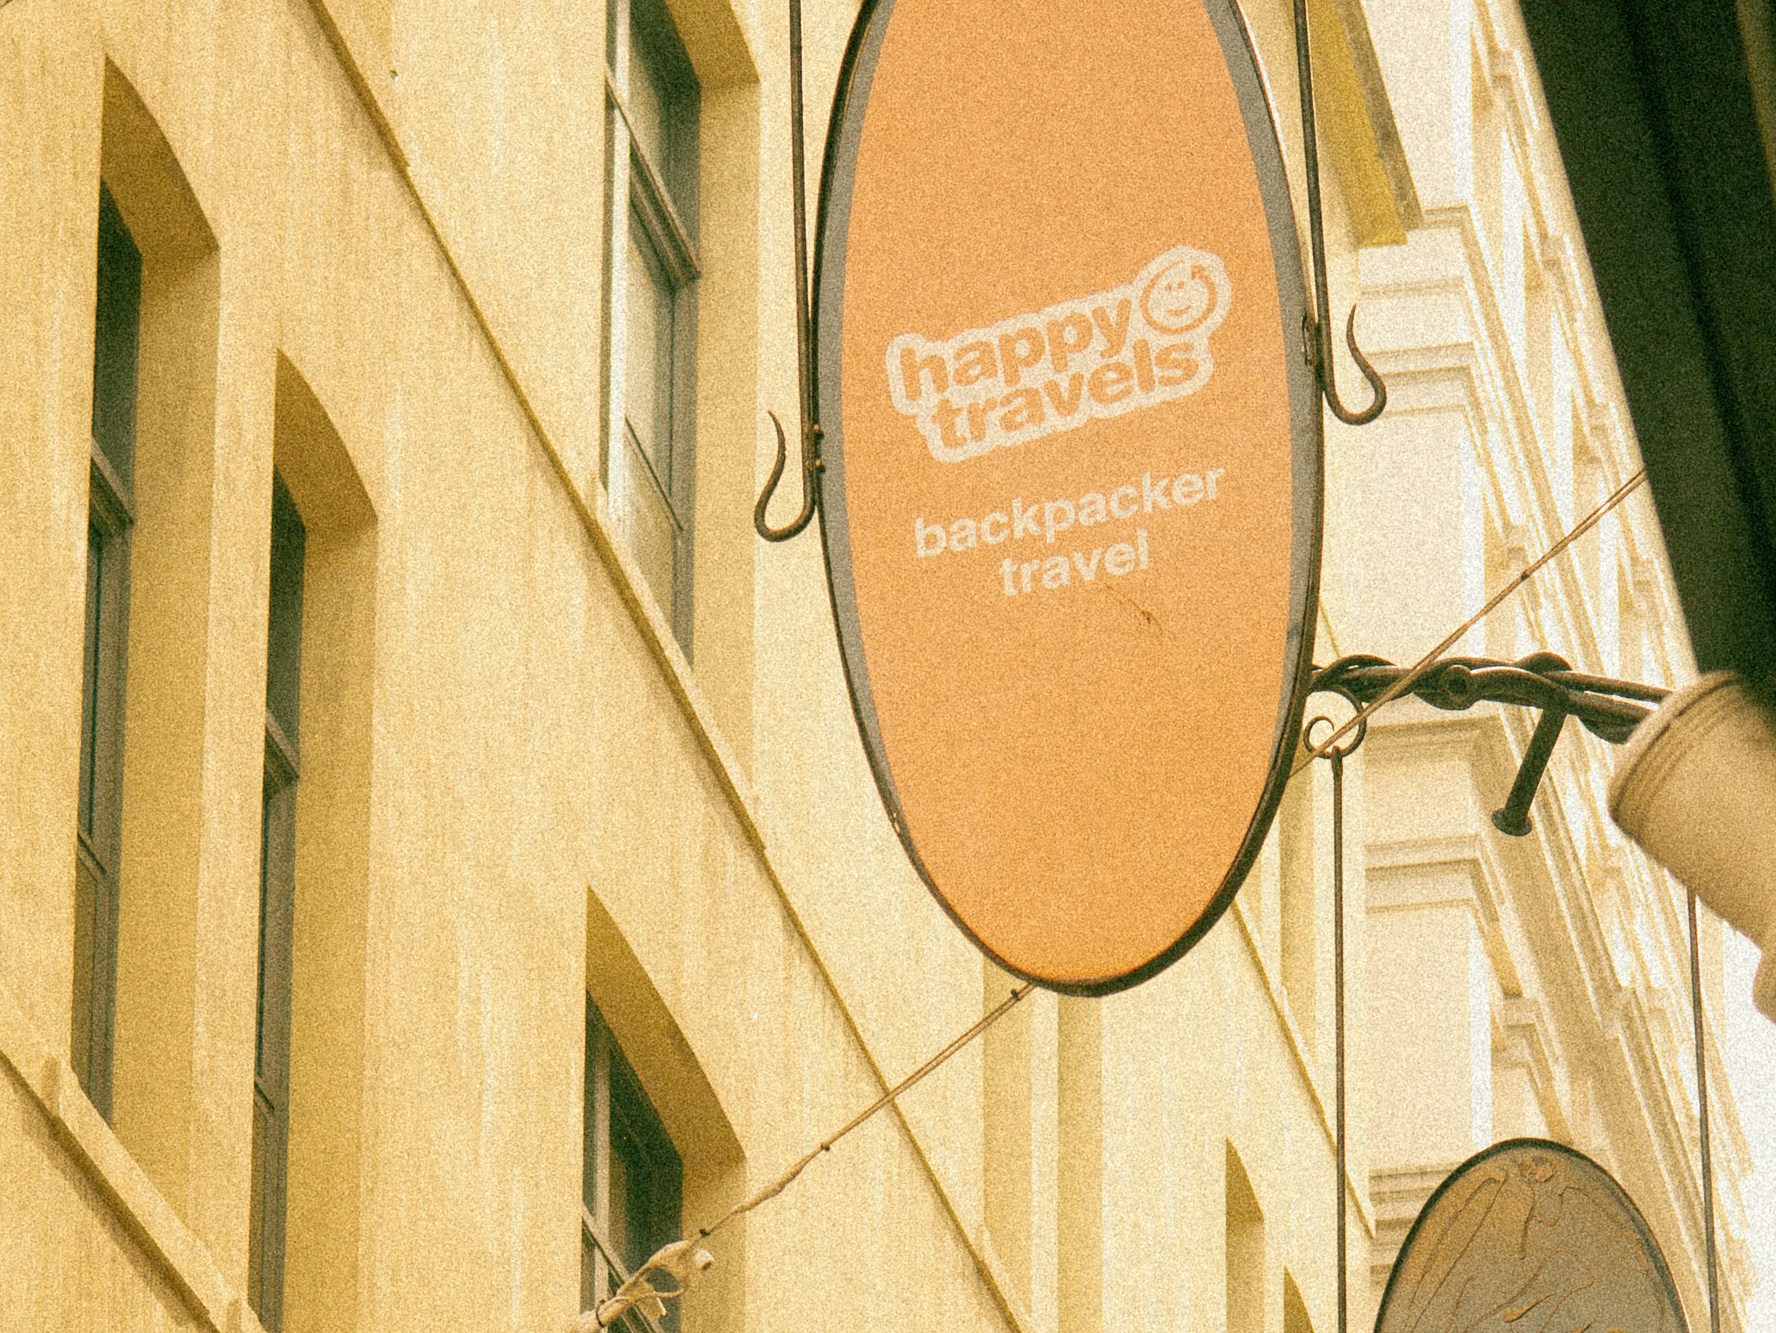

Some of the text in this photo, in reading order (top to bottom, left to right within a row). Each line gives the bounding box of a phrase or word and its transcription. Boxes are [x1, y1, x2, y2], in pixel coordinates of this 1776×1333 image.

[898, 298, 1132, 401] happy
[929, 338, 1200, 449] travels
[913, 467, 1225, 557] backpacker
[999, 527, 1150, 597] travel
